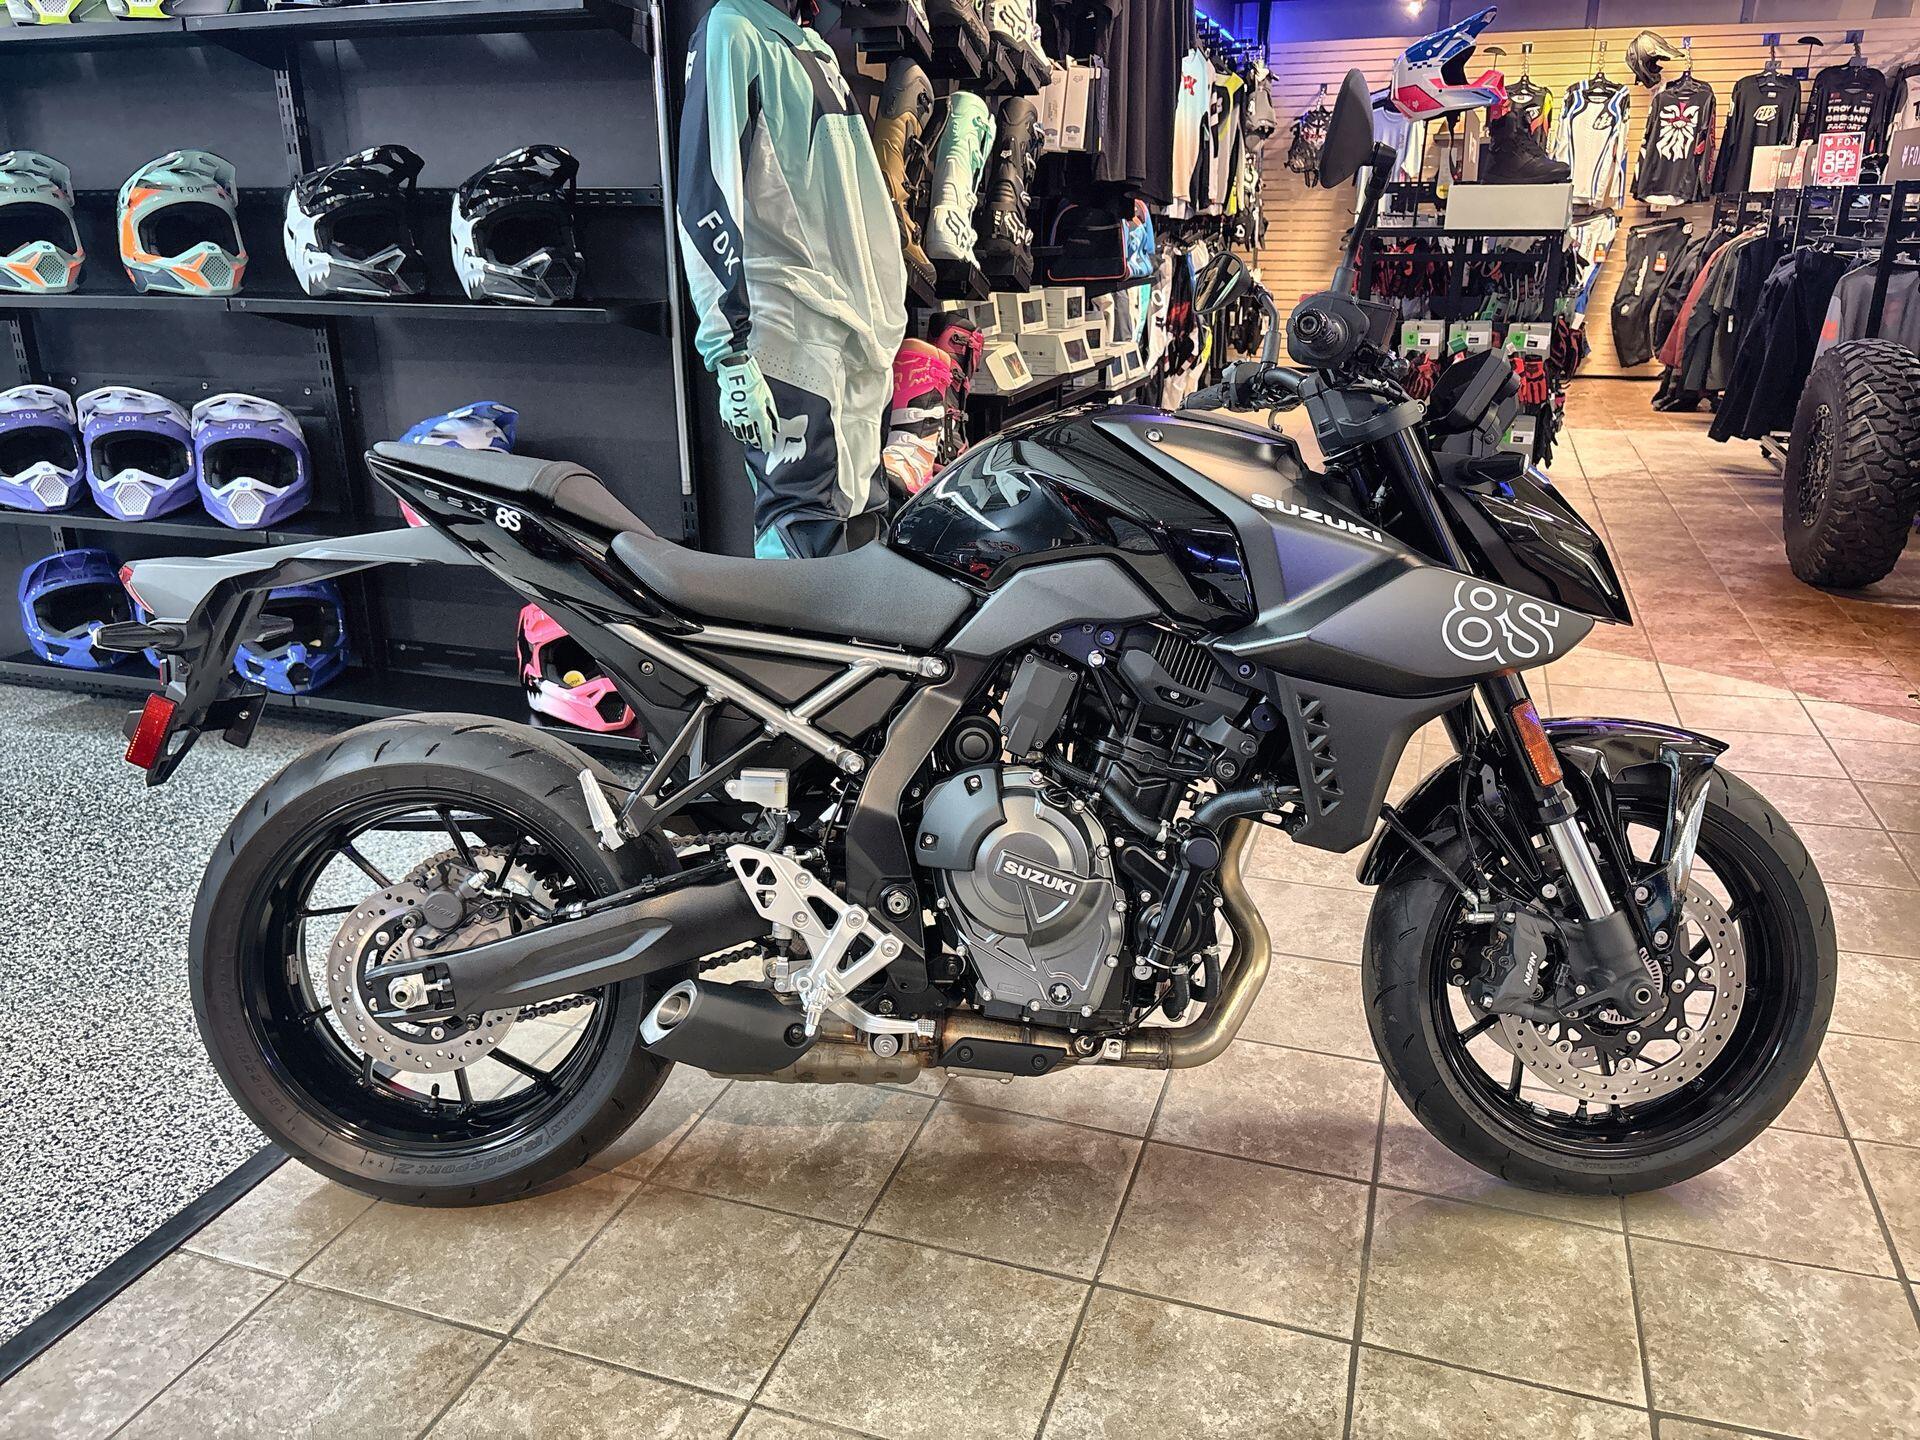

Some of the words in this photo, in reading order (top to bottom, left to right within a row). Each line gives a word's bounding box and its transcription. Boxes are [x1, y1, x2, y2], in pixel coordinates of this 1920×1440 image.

[1827, 105, 1851, 113] TROY
[1825, 114, 1868, 123] DESIGNS
[1836, 137, 1859, 146] FOX
[1824, 149, 1856, 161] 50%
[1821, 161, 1855, 174] OFF
[13, 186, 37, 194] FOX
[180, 185, 202, 193] FOX
[697, 210, 741, 277] FOX
[729, 375, 749, 418] FOX
[19, 412, 38, 420] FOX
[119, 415, 138, 423] FOX
[231, 423, 250, 431] FOX
[424, 489, 487, 516] GSX
[495, 507, 521, 532] 8S
[1251, 493, 1383, 543] SUZUKI
[1003, 860, 1077, 896] SUZUKI
